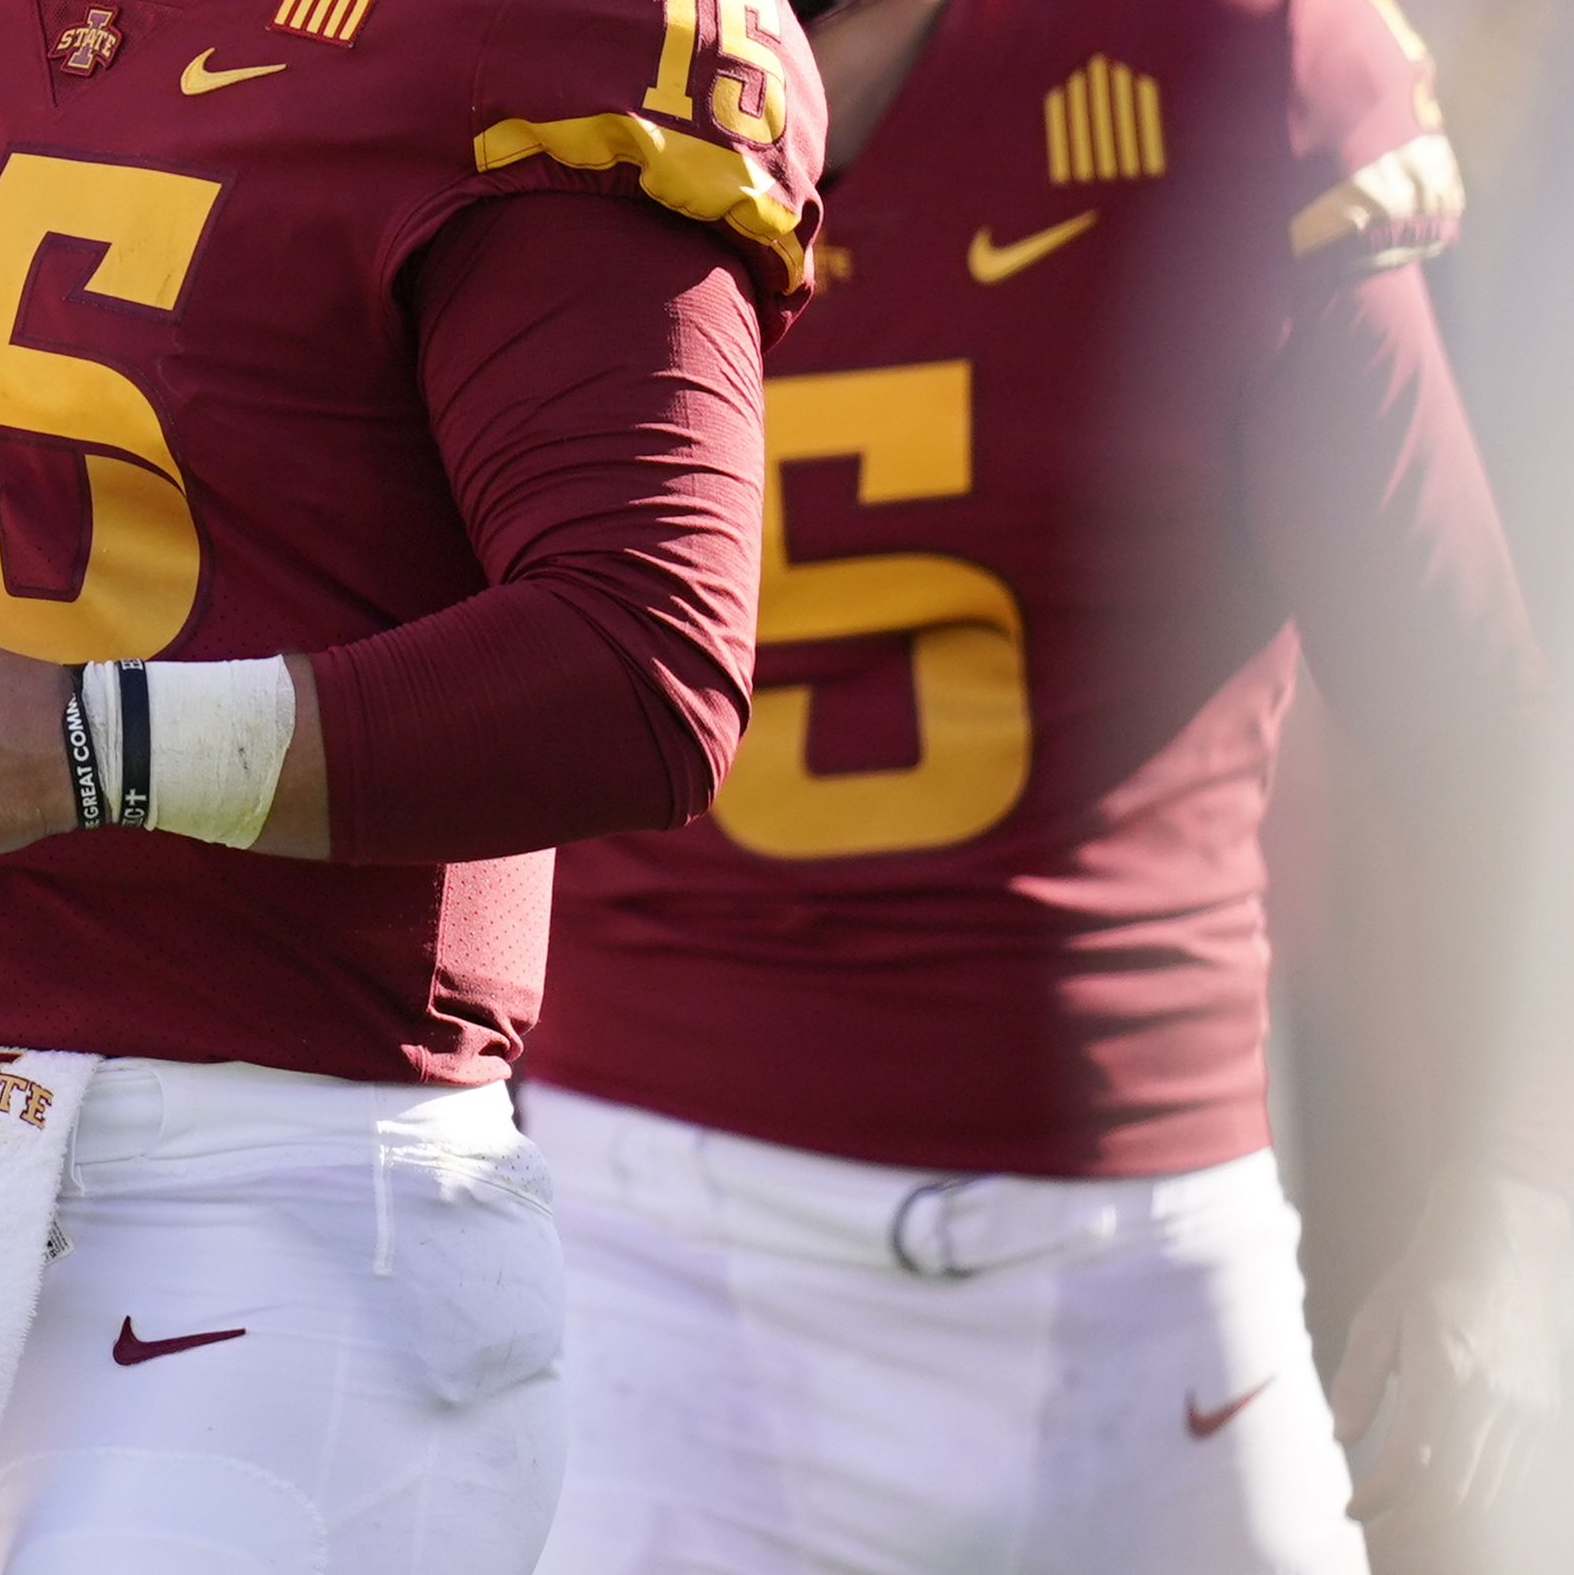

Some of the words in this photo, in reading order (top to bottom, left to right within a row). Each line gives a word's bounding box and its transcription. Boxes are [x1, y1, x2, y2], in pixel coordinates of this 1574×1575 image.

[57, 27, 118, 58] STATE
[66, 692, 90, 762] COMM
[76, 766, 99, 818] GREAT
